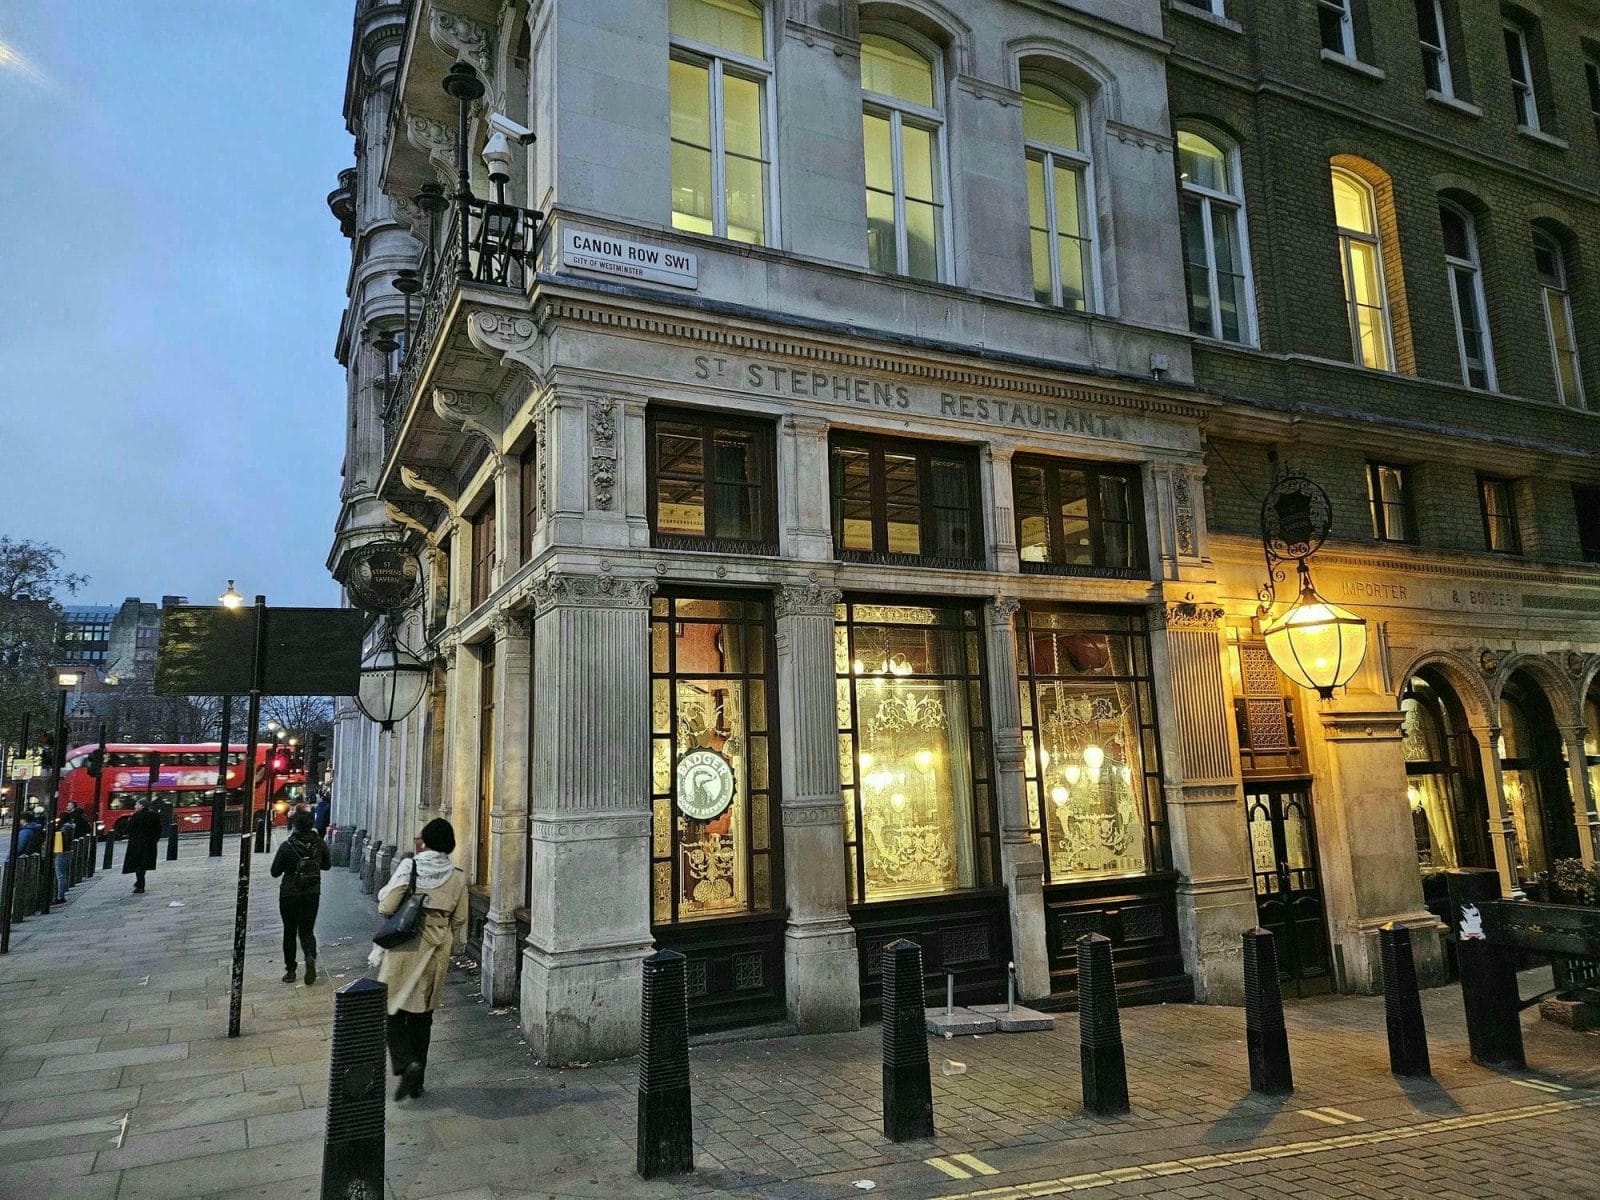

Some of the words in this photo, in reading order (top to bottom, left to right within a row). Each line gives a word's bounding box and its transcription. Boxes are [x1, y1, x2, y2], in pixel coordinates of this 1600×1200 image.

[573, 235, 622, 257] CANON
[628, 246, 659, 264] ROW
[664, 254, 690, 271] SW1
[573, 256, 587, 265] CITY
[598, 261, 644, 276] WESTMINSTER
[679, 754, 728, 776] BADGER
